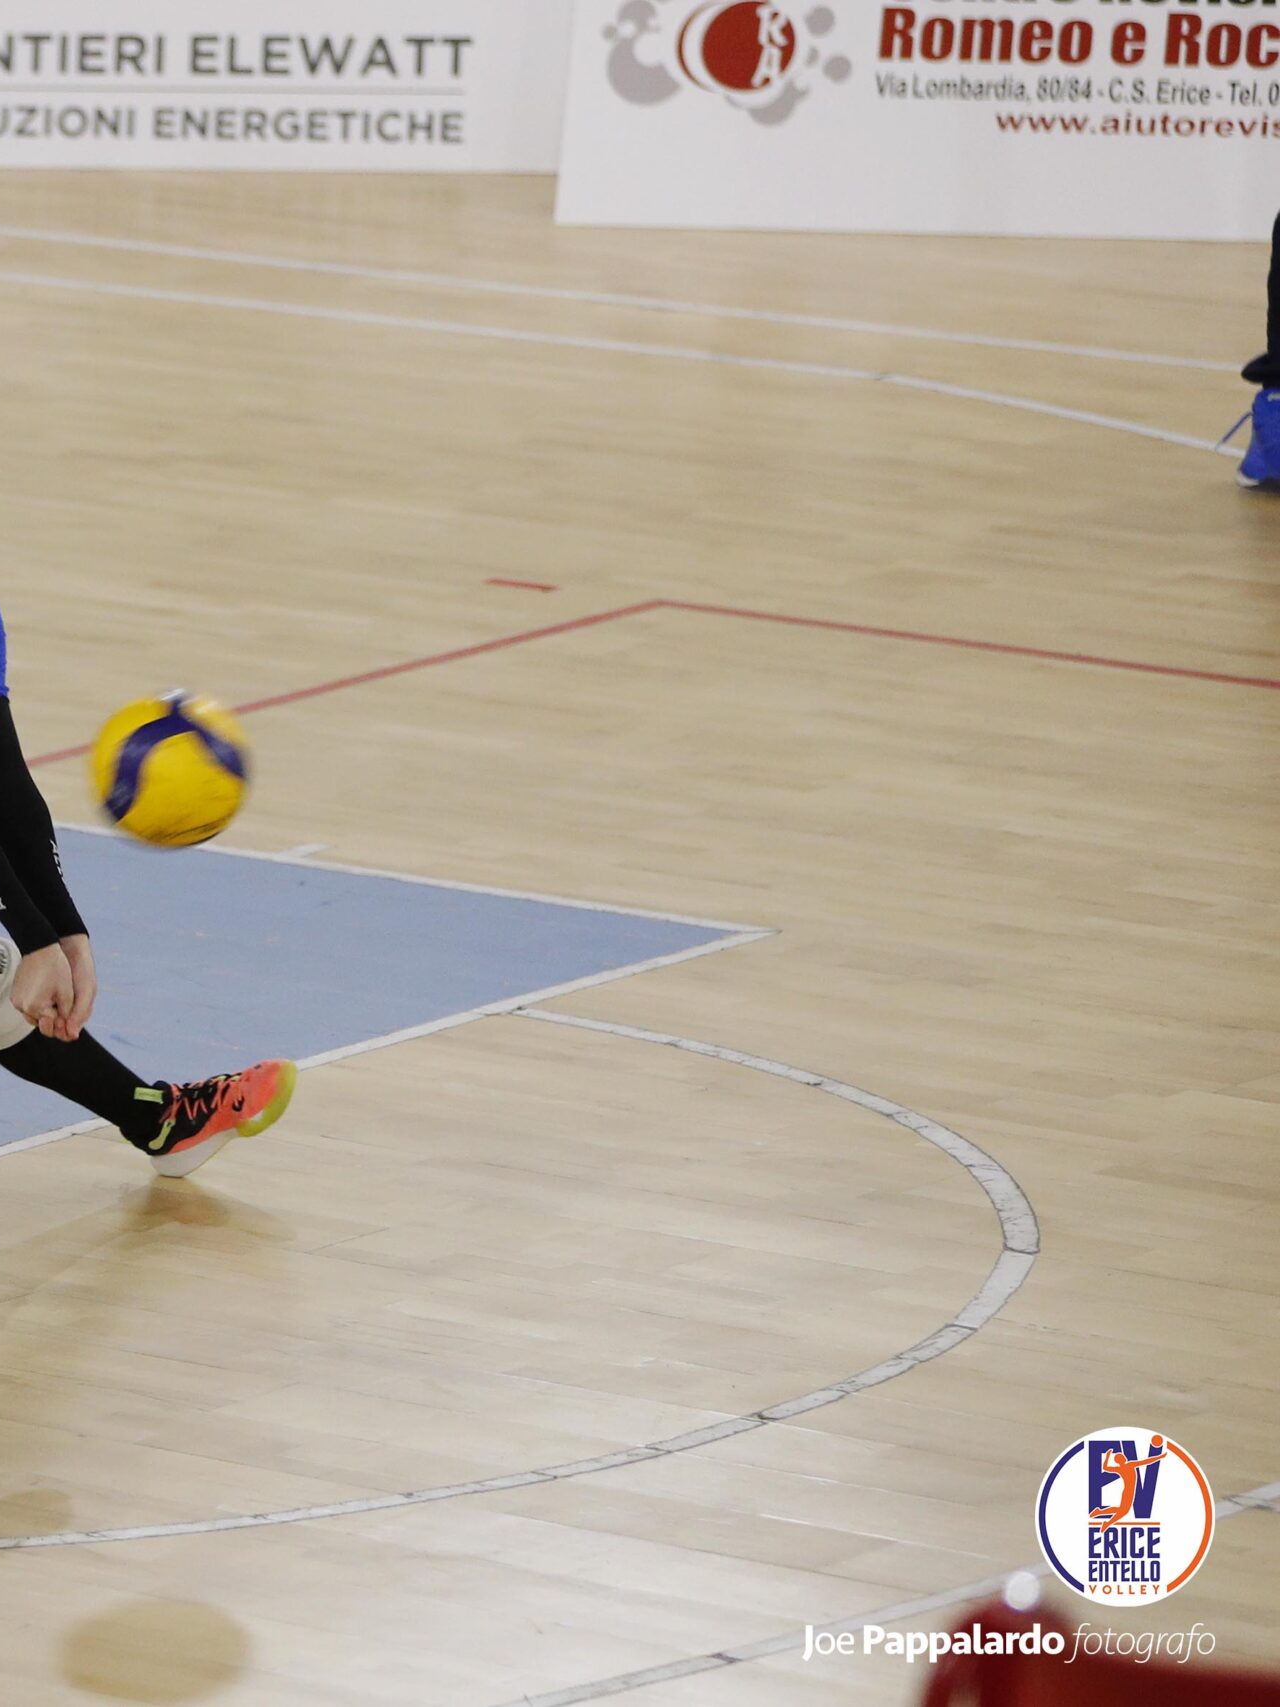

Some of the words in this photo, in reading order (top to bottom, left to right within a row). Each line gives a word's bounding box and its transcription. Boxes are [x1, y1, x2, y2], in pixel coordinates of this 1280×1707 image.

[189, 34, 474, 78] ELEWATT
[878, 7, 1094, 66] Romeo
[1110, 21, 1147, 68] e
[1164, 13, 1280, 70] Roc
[875, 71, 908, 98] Via
[912, 72, 1031, 105] Lombardia,
[1036, 74, 1092, 102] 80/84
[1108, 77, 1150, 104] C.S.
[1156, 78, 1211, 106] Erice
[1228, 80, 1262, 107] Tel.
[153, 107, 465, 144] ENERGETICHE
